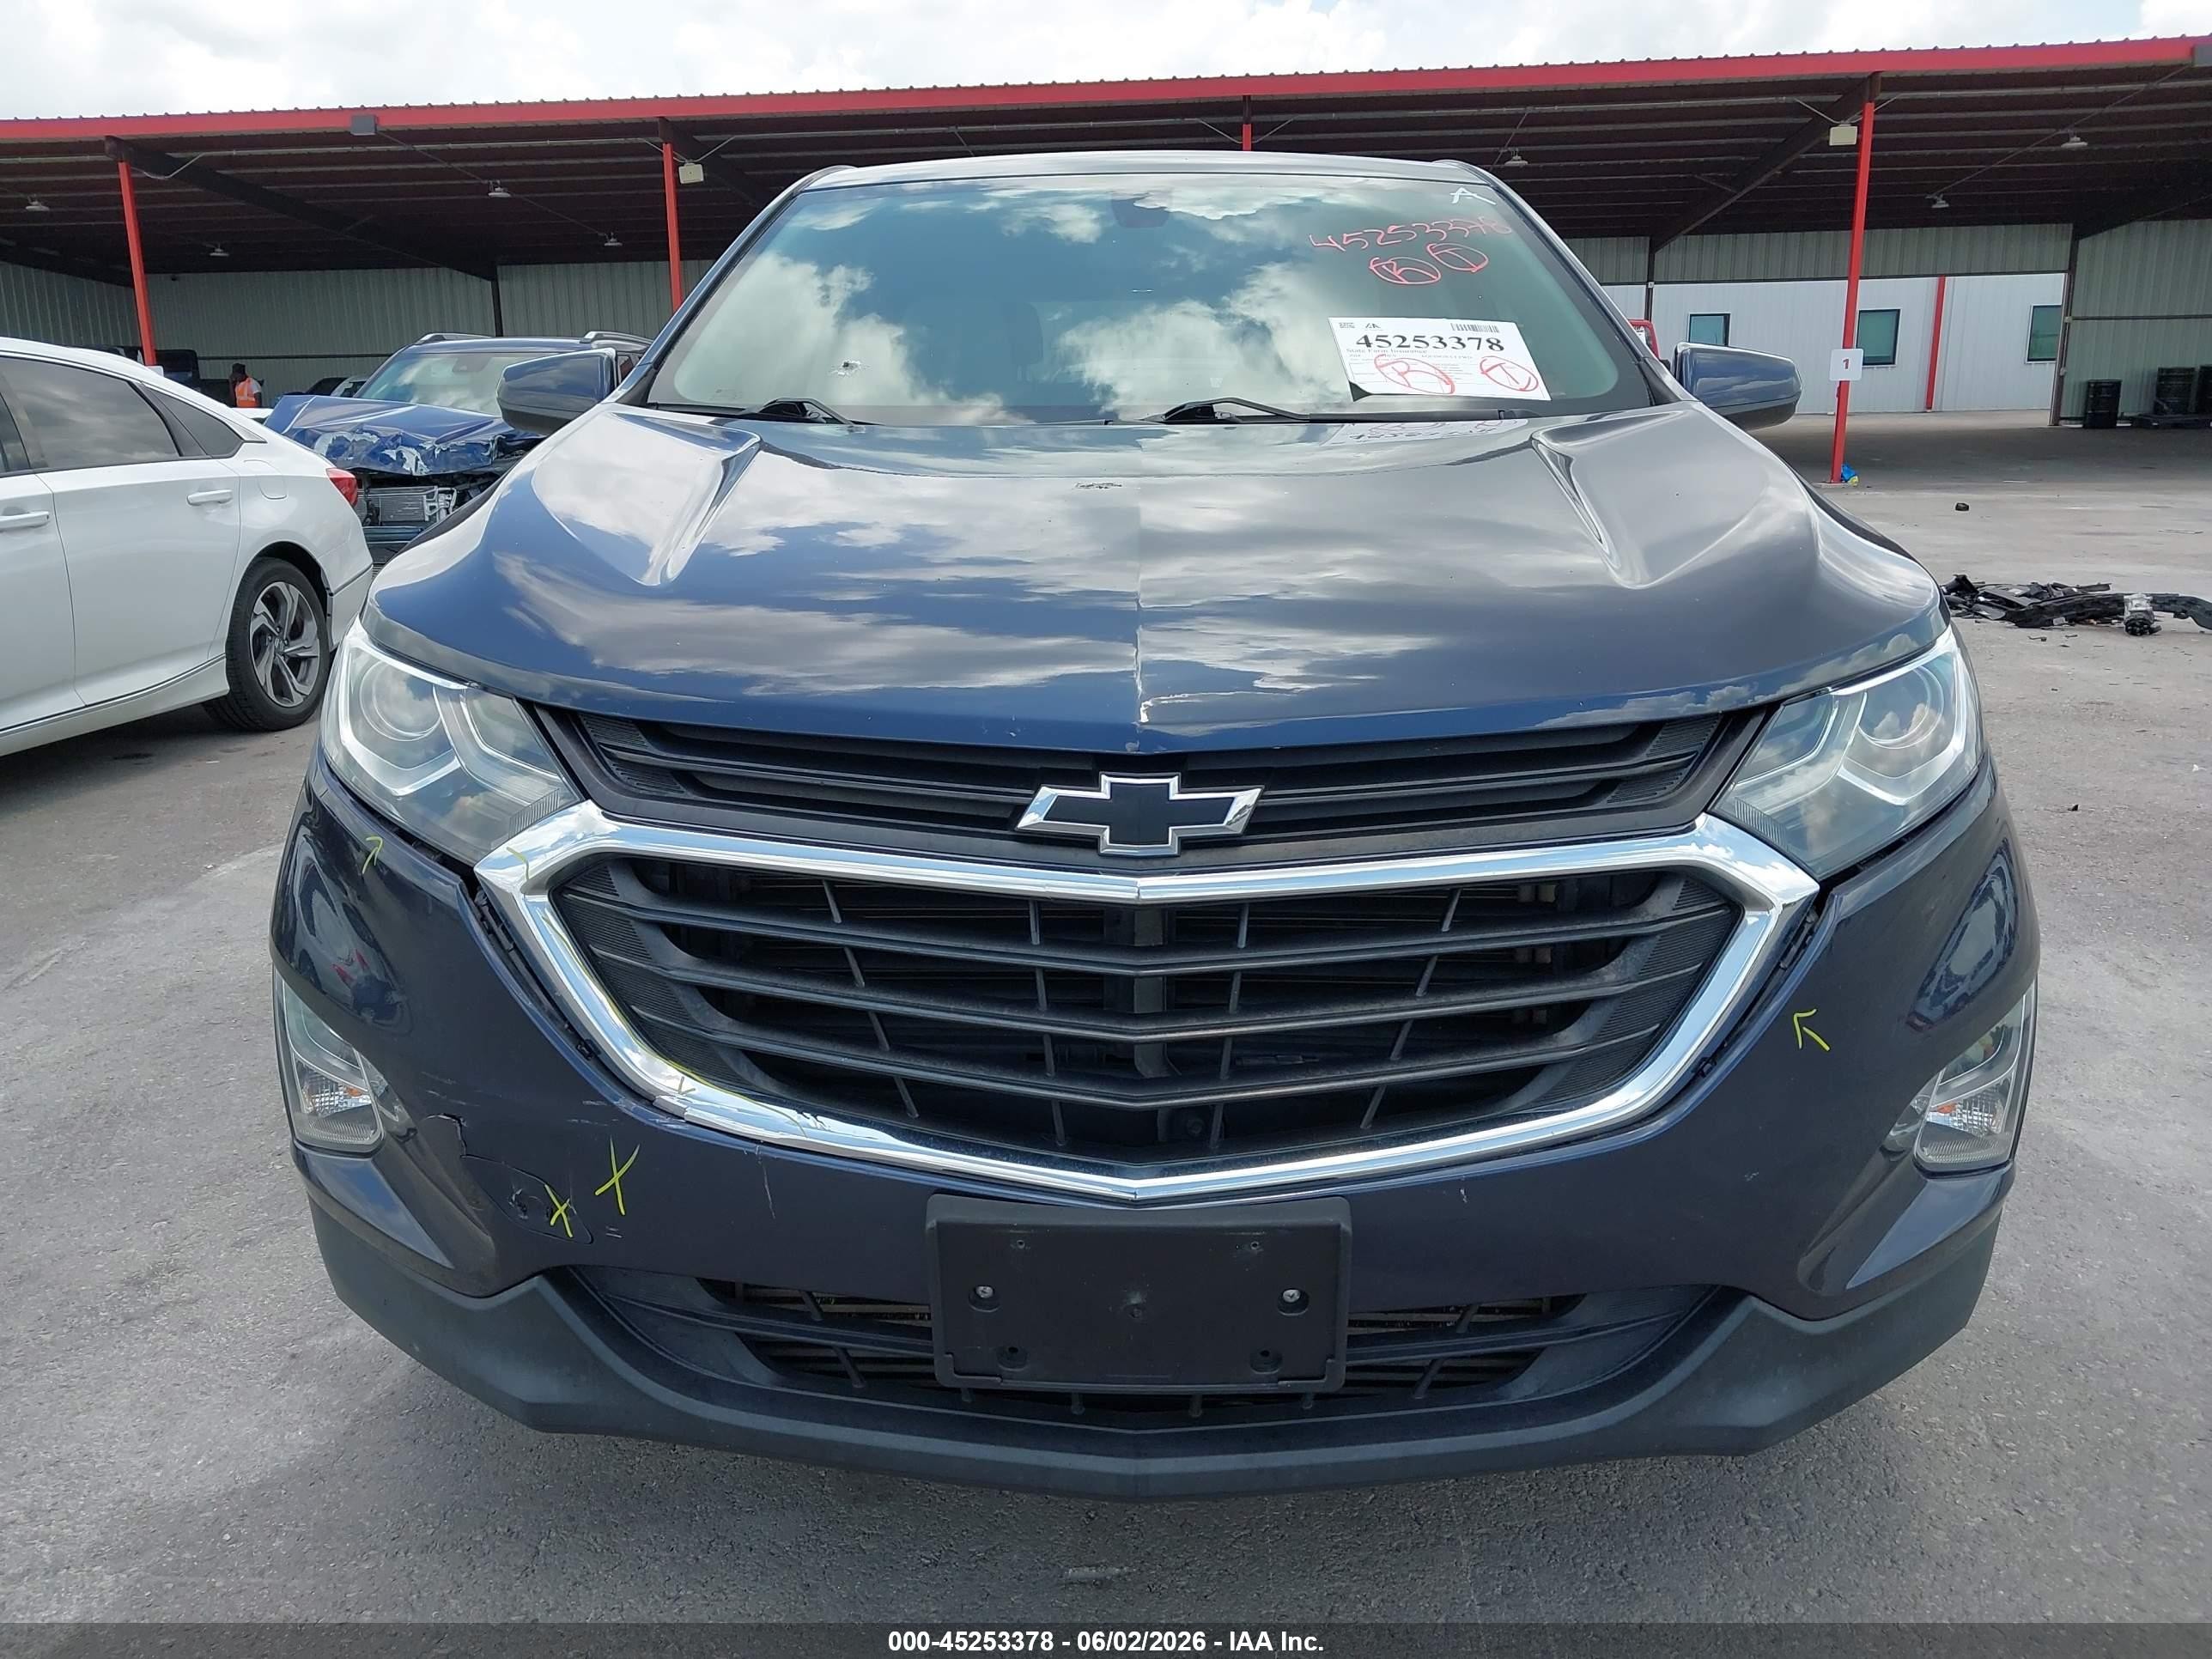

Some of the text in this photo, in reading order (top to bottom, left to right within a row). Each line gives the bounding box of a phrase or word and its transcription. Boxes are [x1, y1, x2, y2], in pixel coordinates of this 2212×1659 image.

[1310, 216, 1512, 252] 45253378
[1356, 334, 1504, 352] 45253378
[1843, 358, 1850, 369] 1
